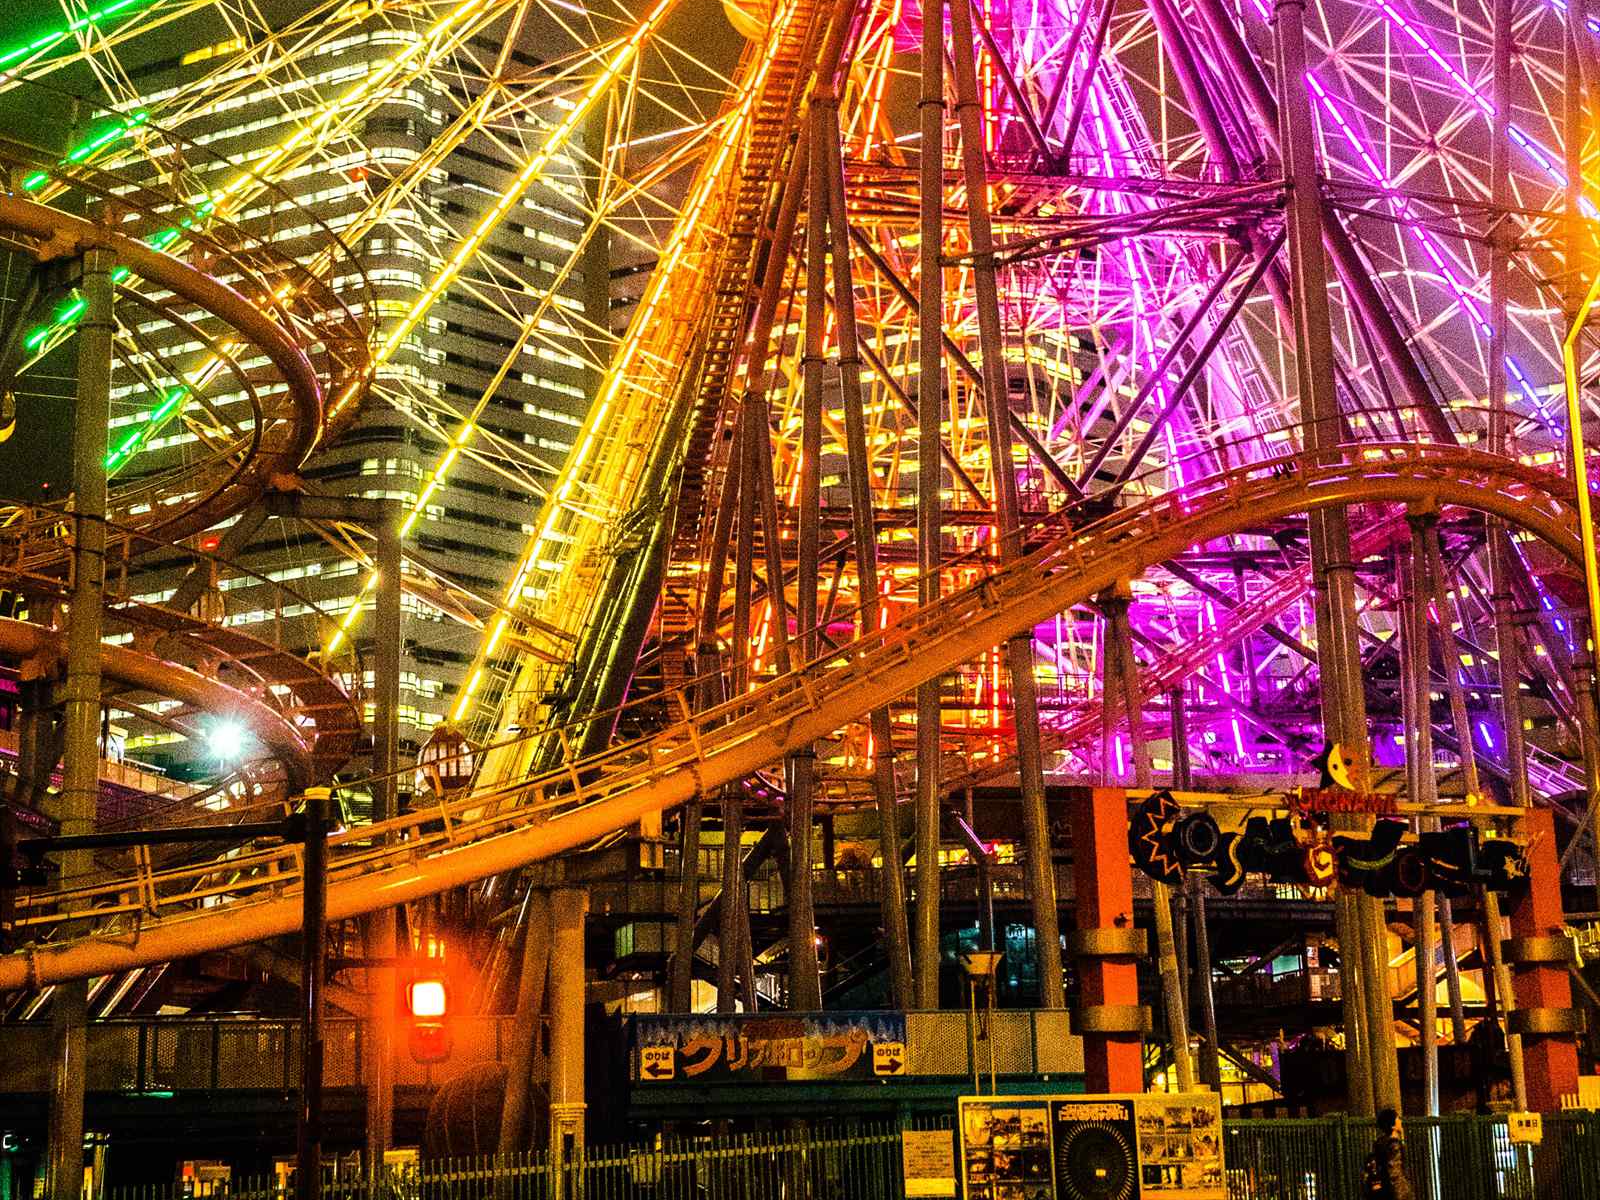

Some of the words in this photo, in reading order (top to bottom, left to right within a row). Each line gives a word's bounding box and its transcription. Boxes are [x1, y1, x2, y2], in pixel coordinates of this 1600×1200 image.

[644, 1051, 671, 1061] のりば
[876, 1047, 901, 1057] のりば
